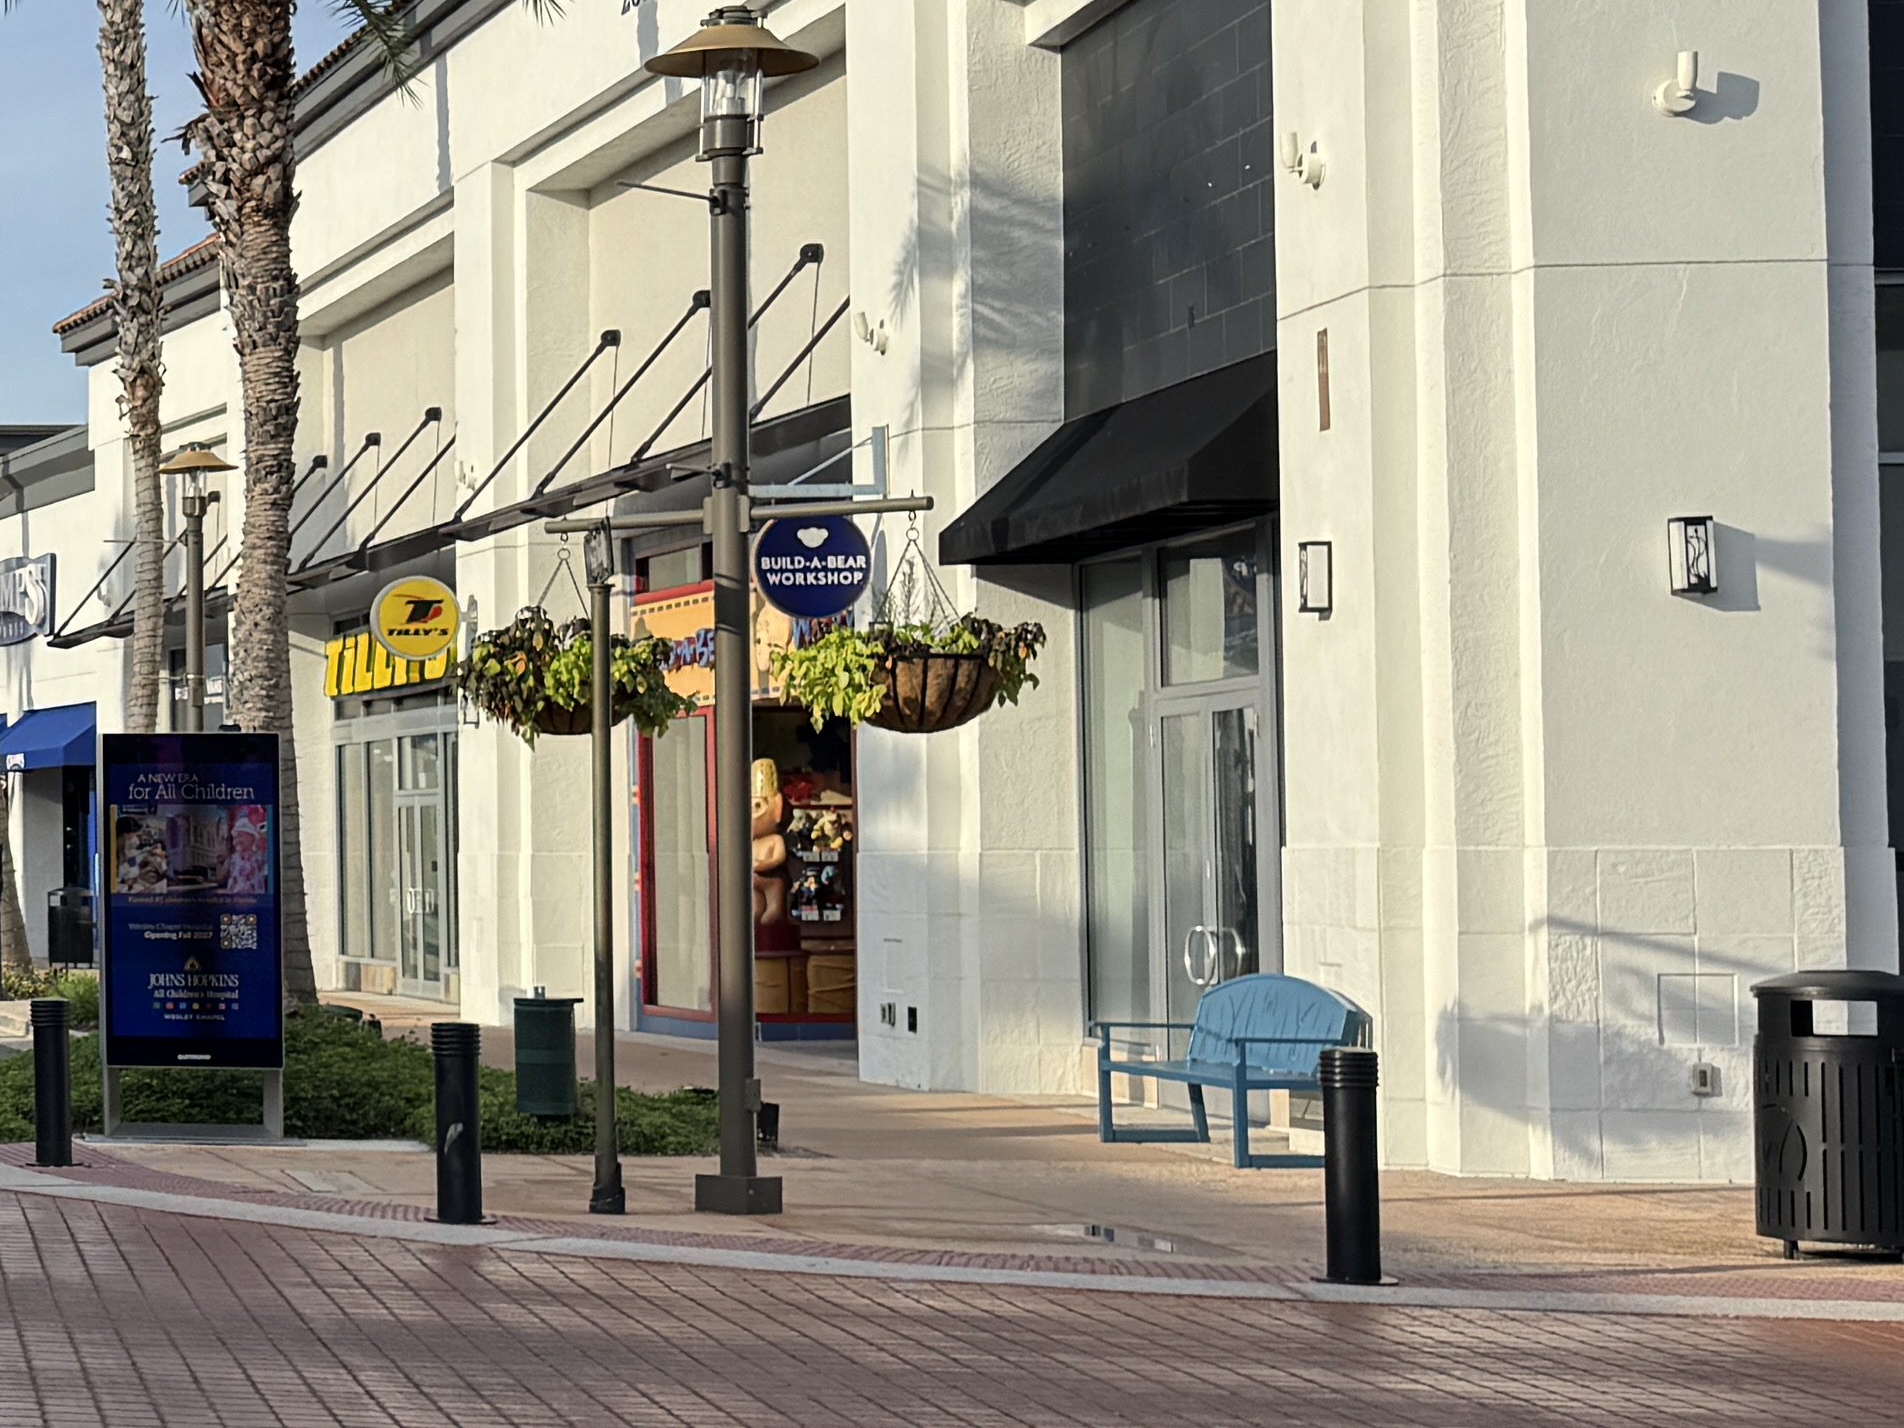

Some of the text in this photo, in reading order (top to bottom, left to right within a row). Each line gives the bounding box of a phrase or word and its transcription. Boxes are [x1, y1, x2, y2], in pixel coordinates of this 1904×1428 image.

[761, 555, 866, 570] BUILD-A-BEAR
[767, 571, 863, 585] WORKSHOP
[137, 774, 146, 782] A
[149, 774, 176, 783] NEW
[129, 783, 255, 800] for All Children
[144, 932, 178, 940] Opening
[148, 973, 239, 989] JOHNS HOPKINS
[153, 989, 165, 998] All
